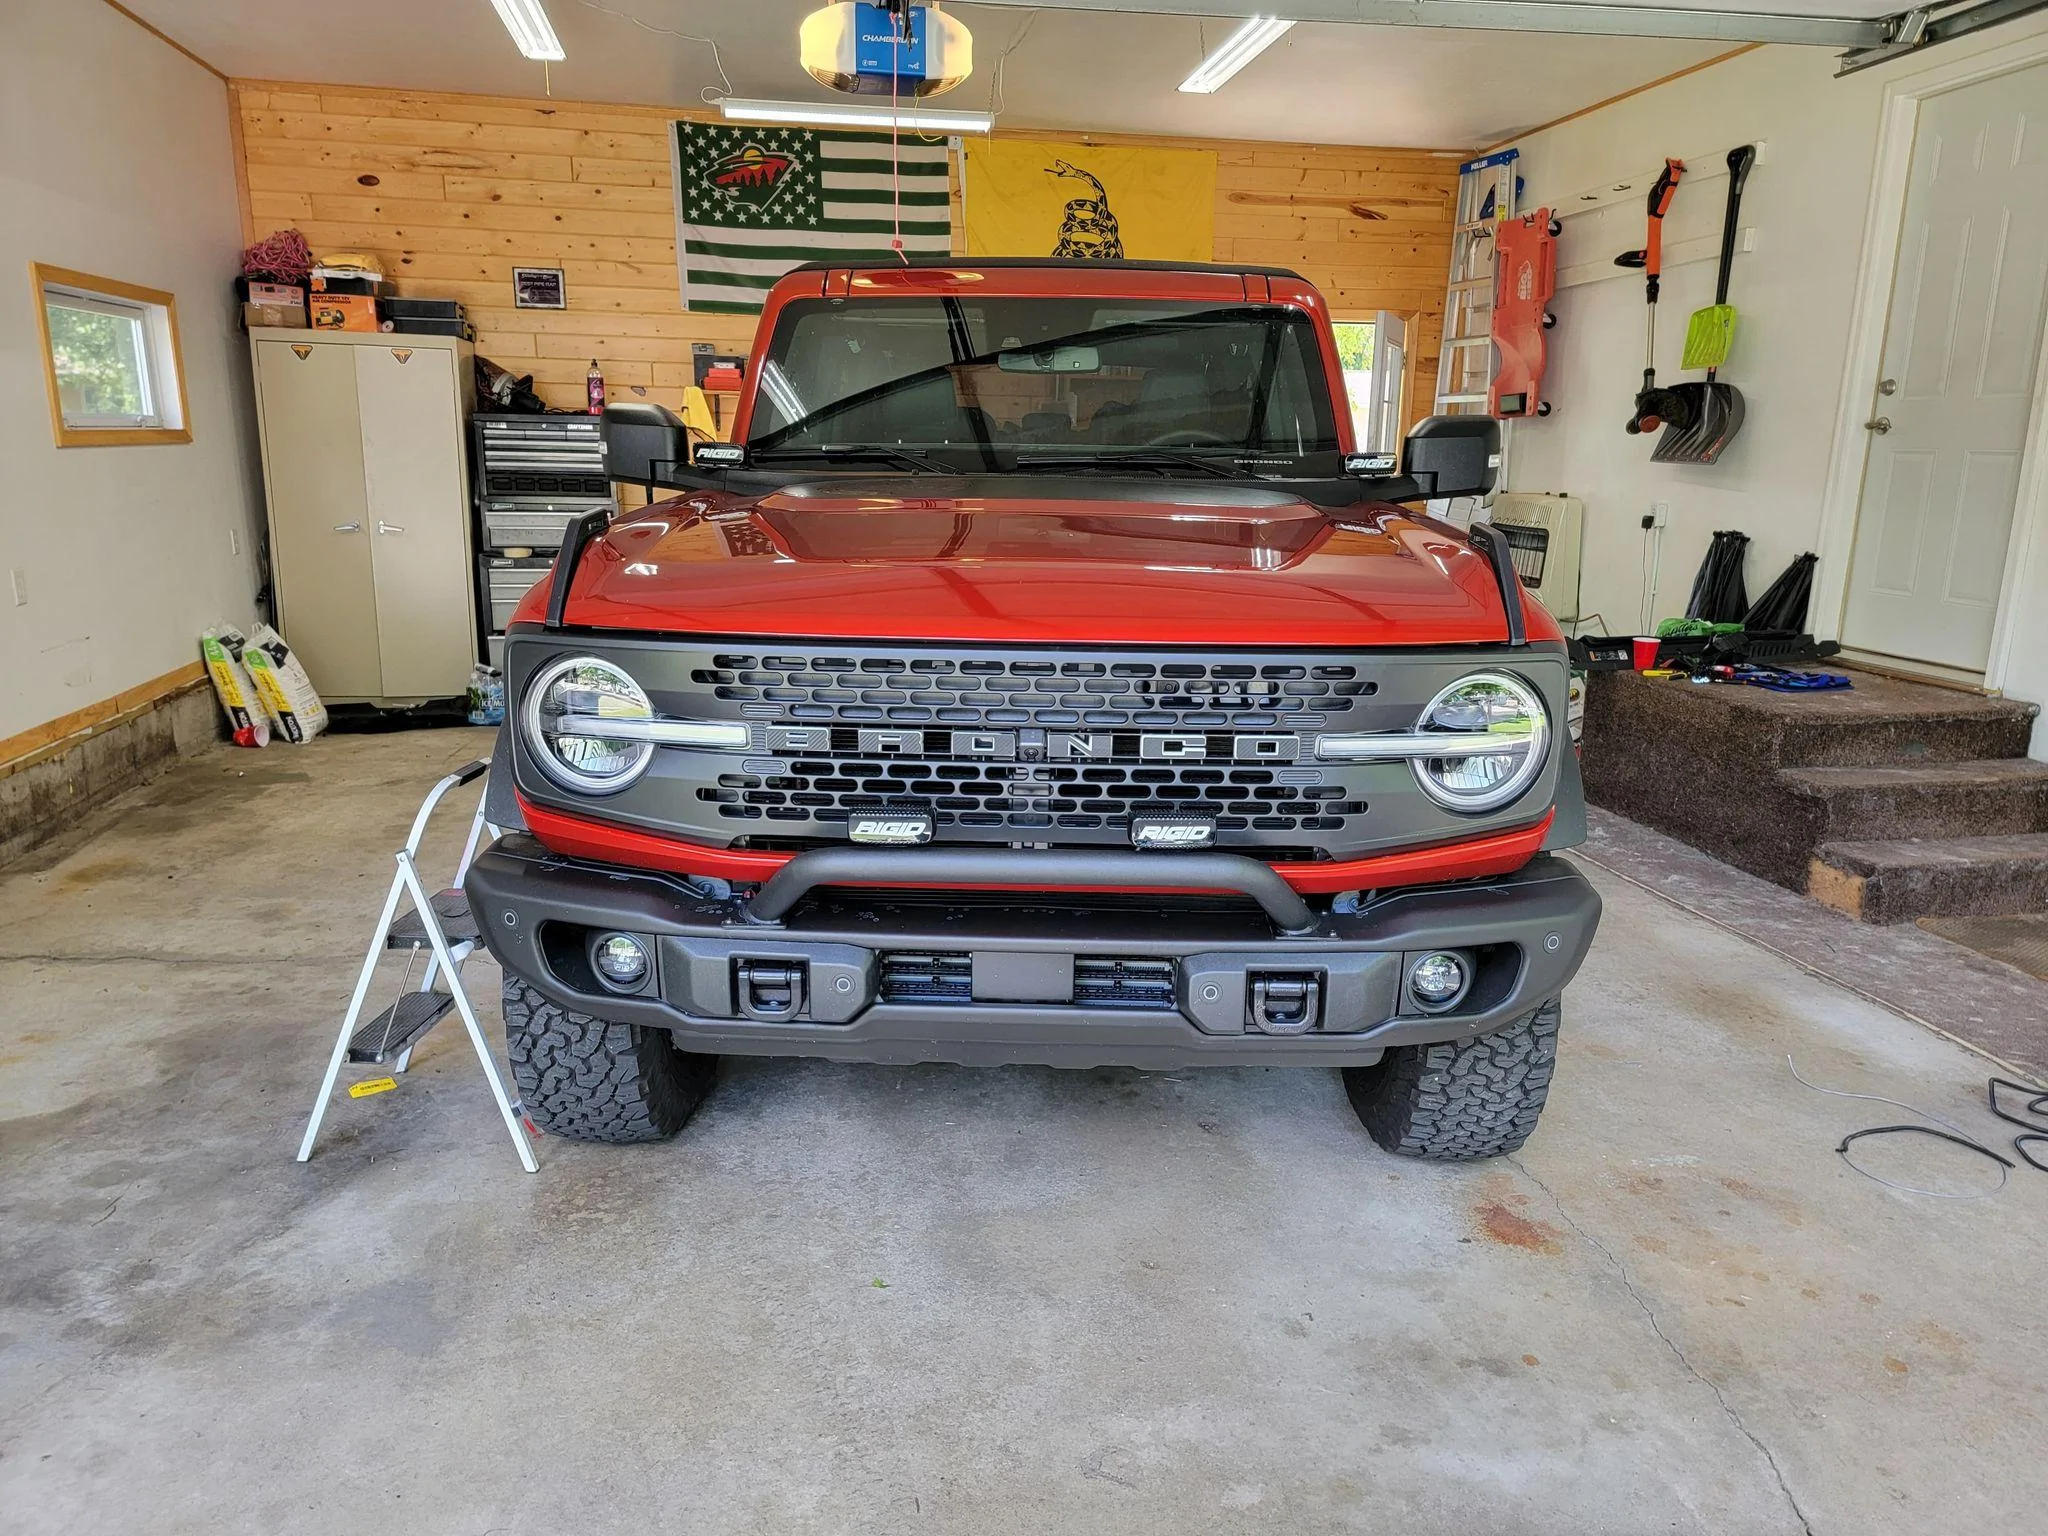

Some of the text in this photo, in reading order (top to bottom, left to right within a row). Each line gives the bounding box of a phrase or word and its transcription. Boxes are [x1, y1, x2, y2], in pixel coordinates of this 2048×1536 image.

[696, 447, 741, 460] RIGID
[1349, 458, 1394, 469] RIGID
[765, 725, 1300, 760] BRONCO
[854, 821, 927, 837] RIGID
[1137, 825, 1211, 840] RIGID
